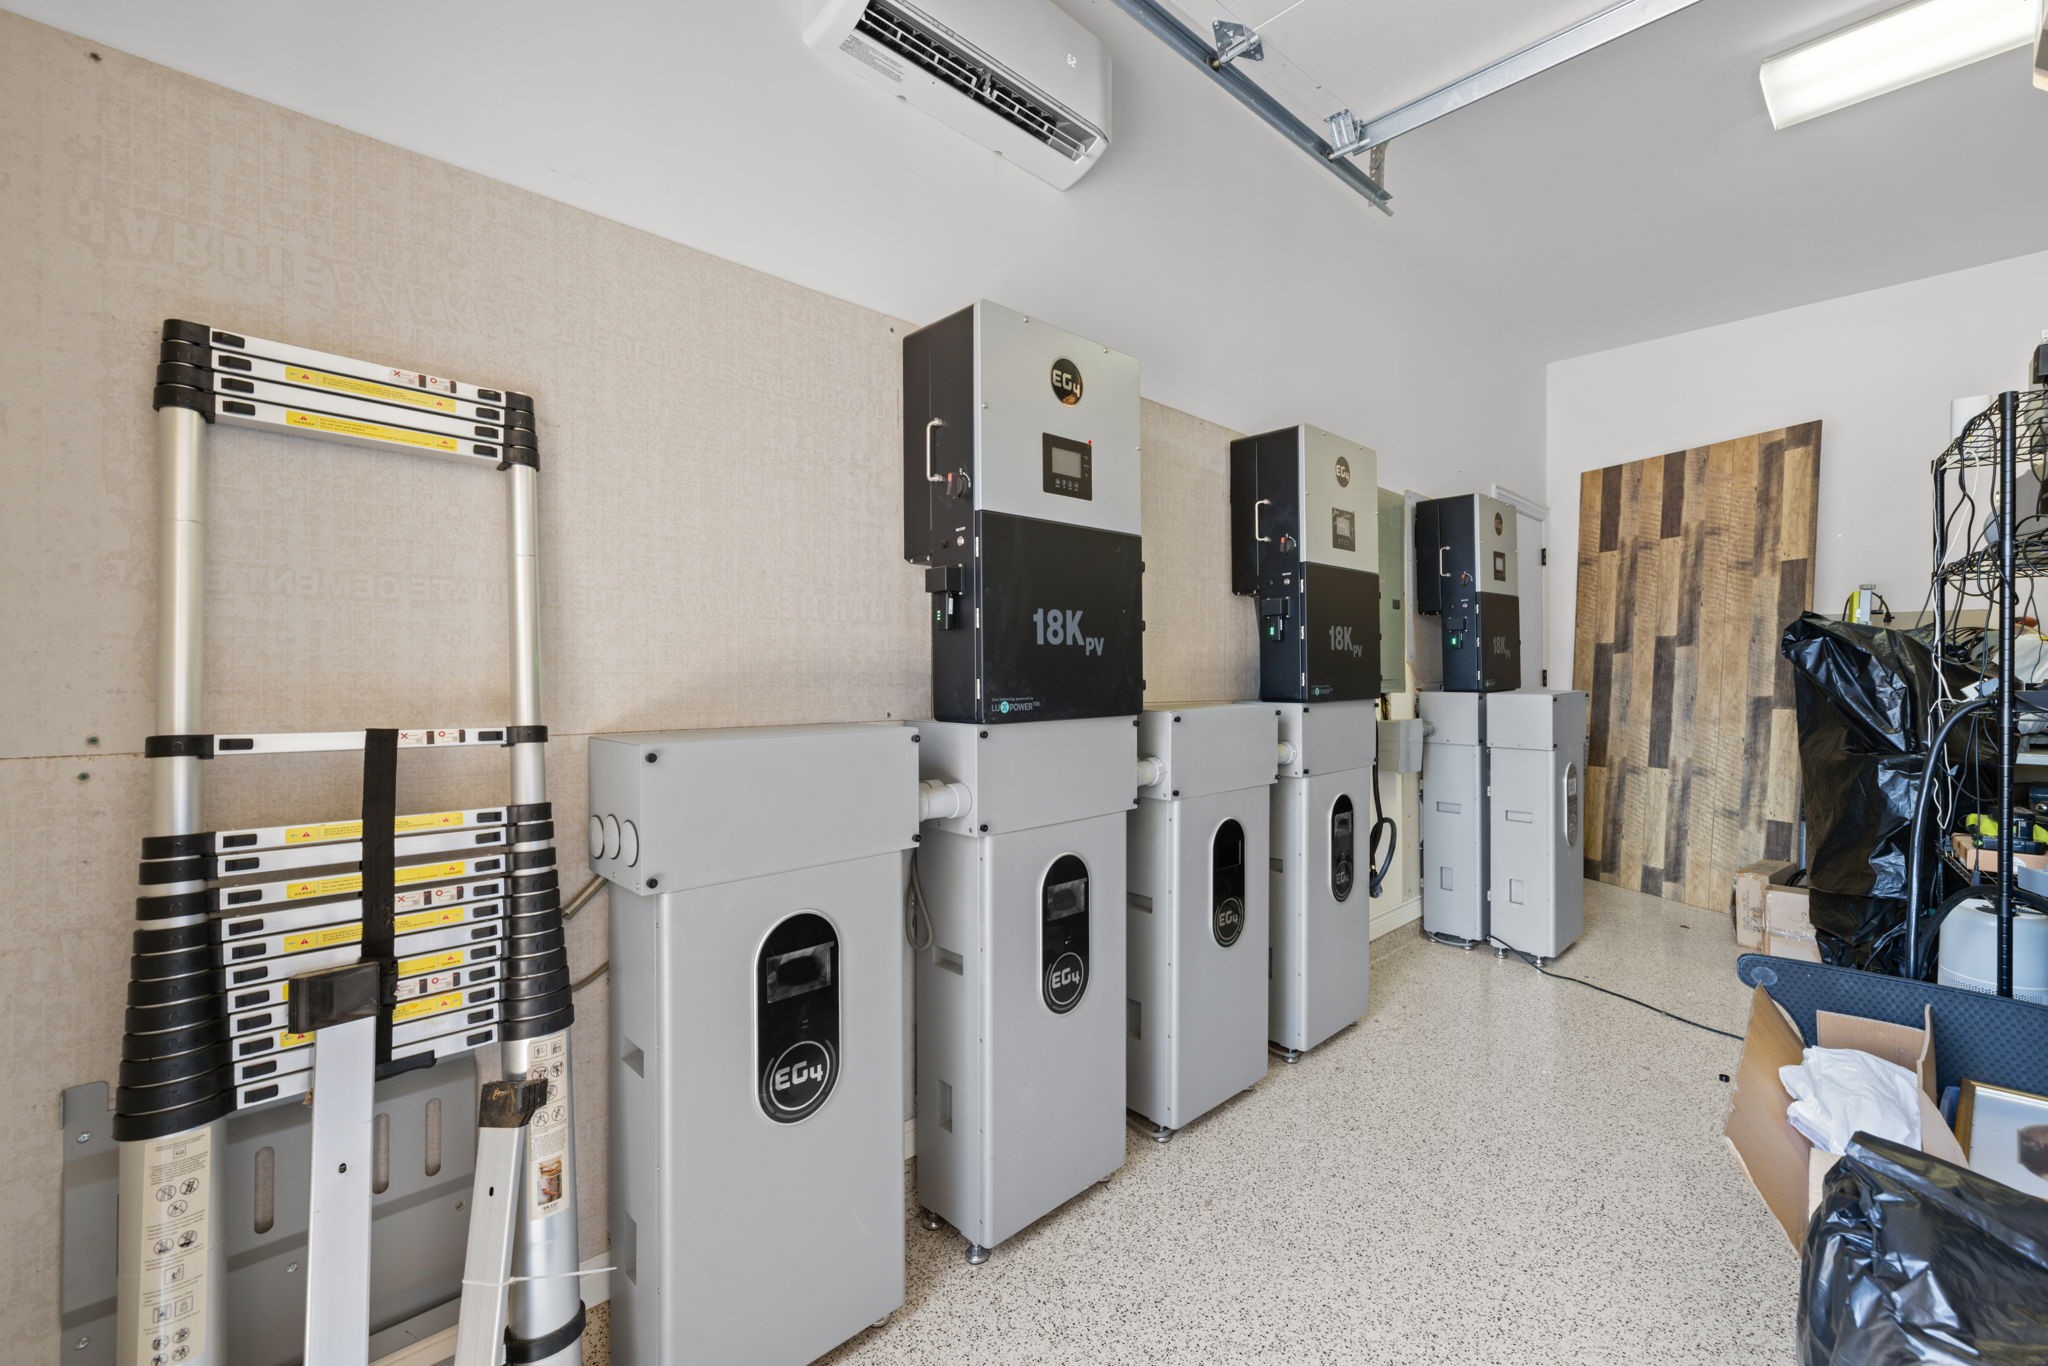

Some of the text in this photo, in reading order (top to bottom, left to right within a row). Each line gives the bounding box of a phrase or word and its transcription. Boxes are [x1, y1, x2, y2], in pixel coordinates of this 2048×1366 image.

[1052, 369, 1080, 398] EG4
[1336, 464, 1350, 480] EG4
[1219, 910, 1238, 927] EG4
[1051, 967, 1081, 989] EG4
[774, 1060, 824, 1091] EG4
